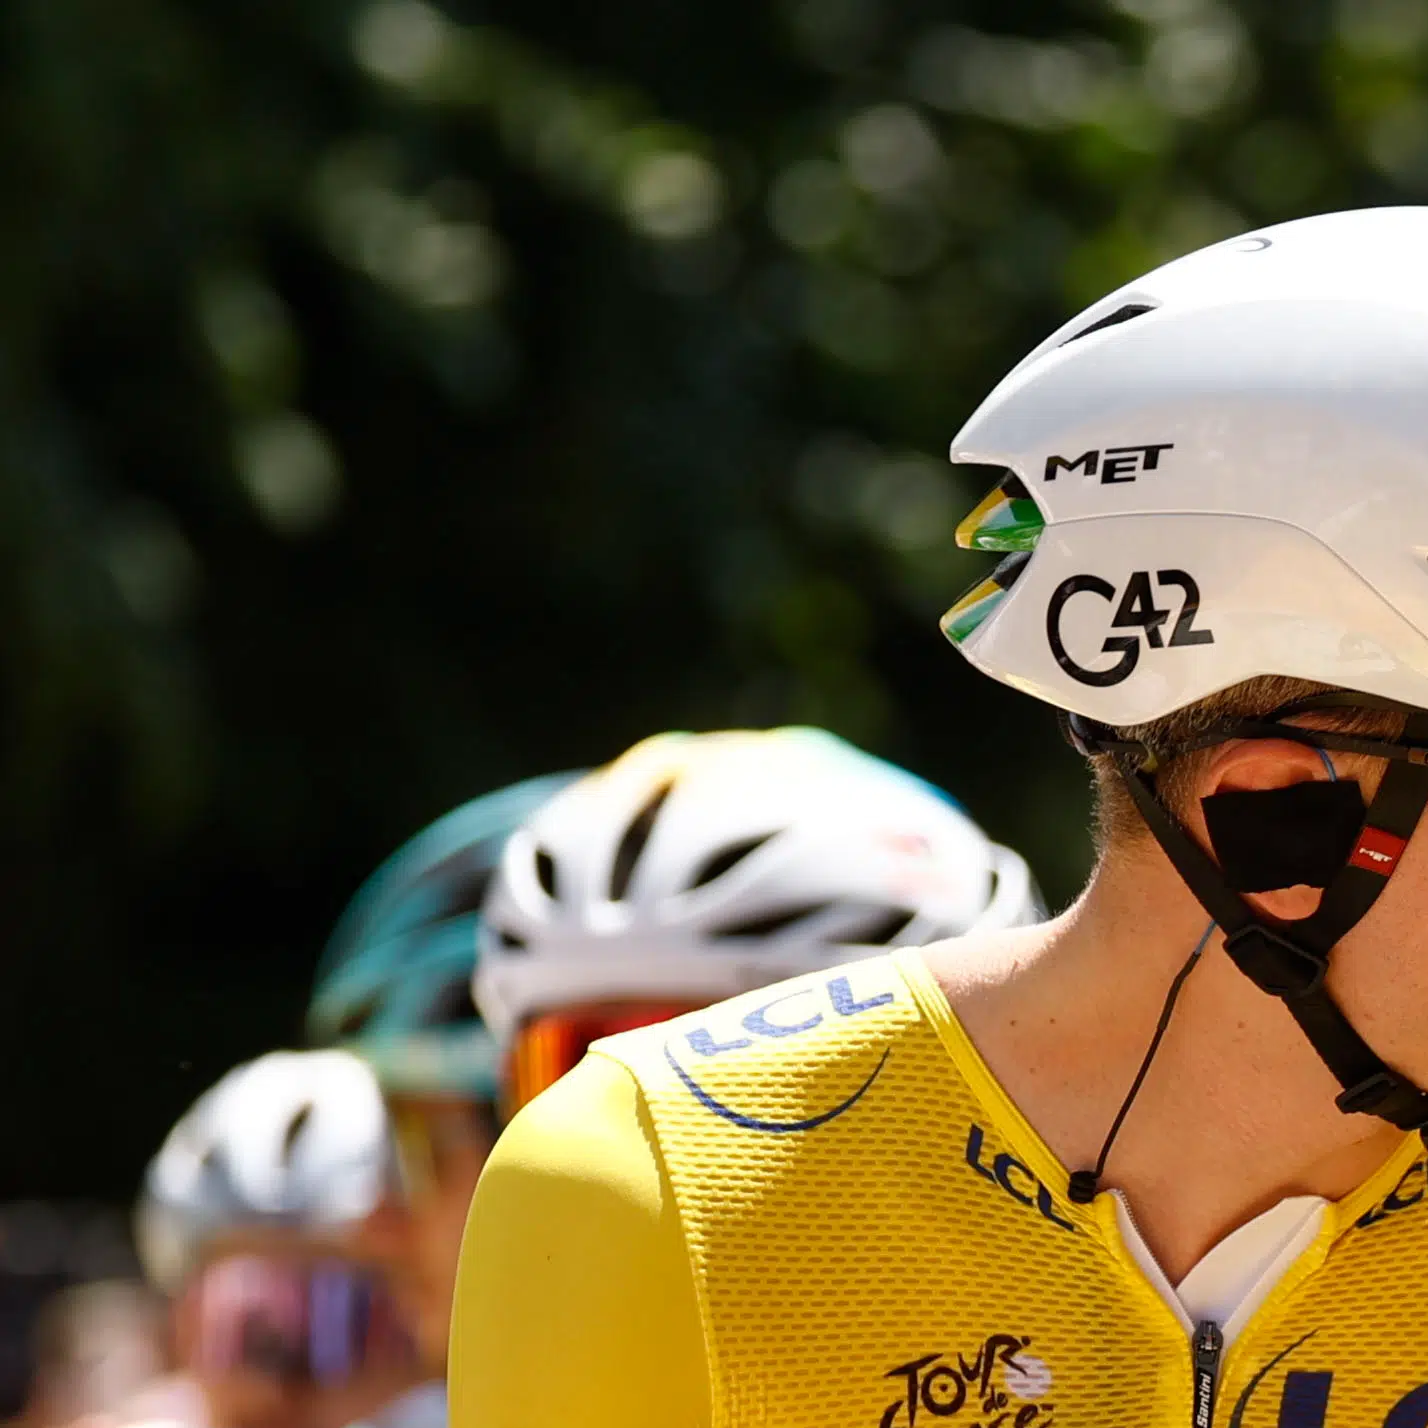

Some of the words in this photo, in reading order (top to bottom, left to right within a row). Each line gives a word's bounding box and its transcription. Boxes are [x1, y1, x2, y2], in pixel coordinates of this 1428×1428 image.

[1043, 442, 1174, 485] MET
[1045, 568, 1215, 688] G42
[682, 975, 895, 1057] LCL
[965, 1122, 1076, 1233] LCL
[982, 1384, 1009, 1415] de
